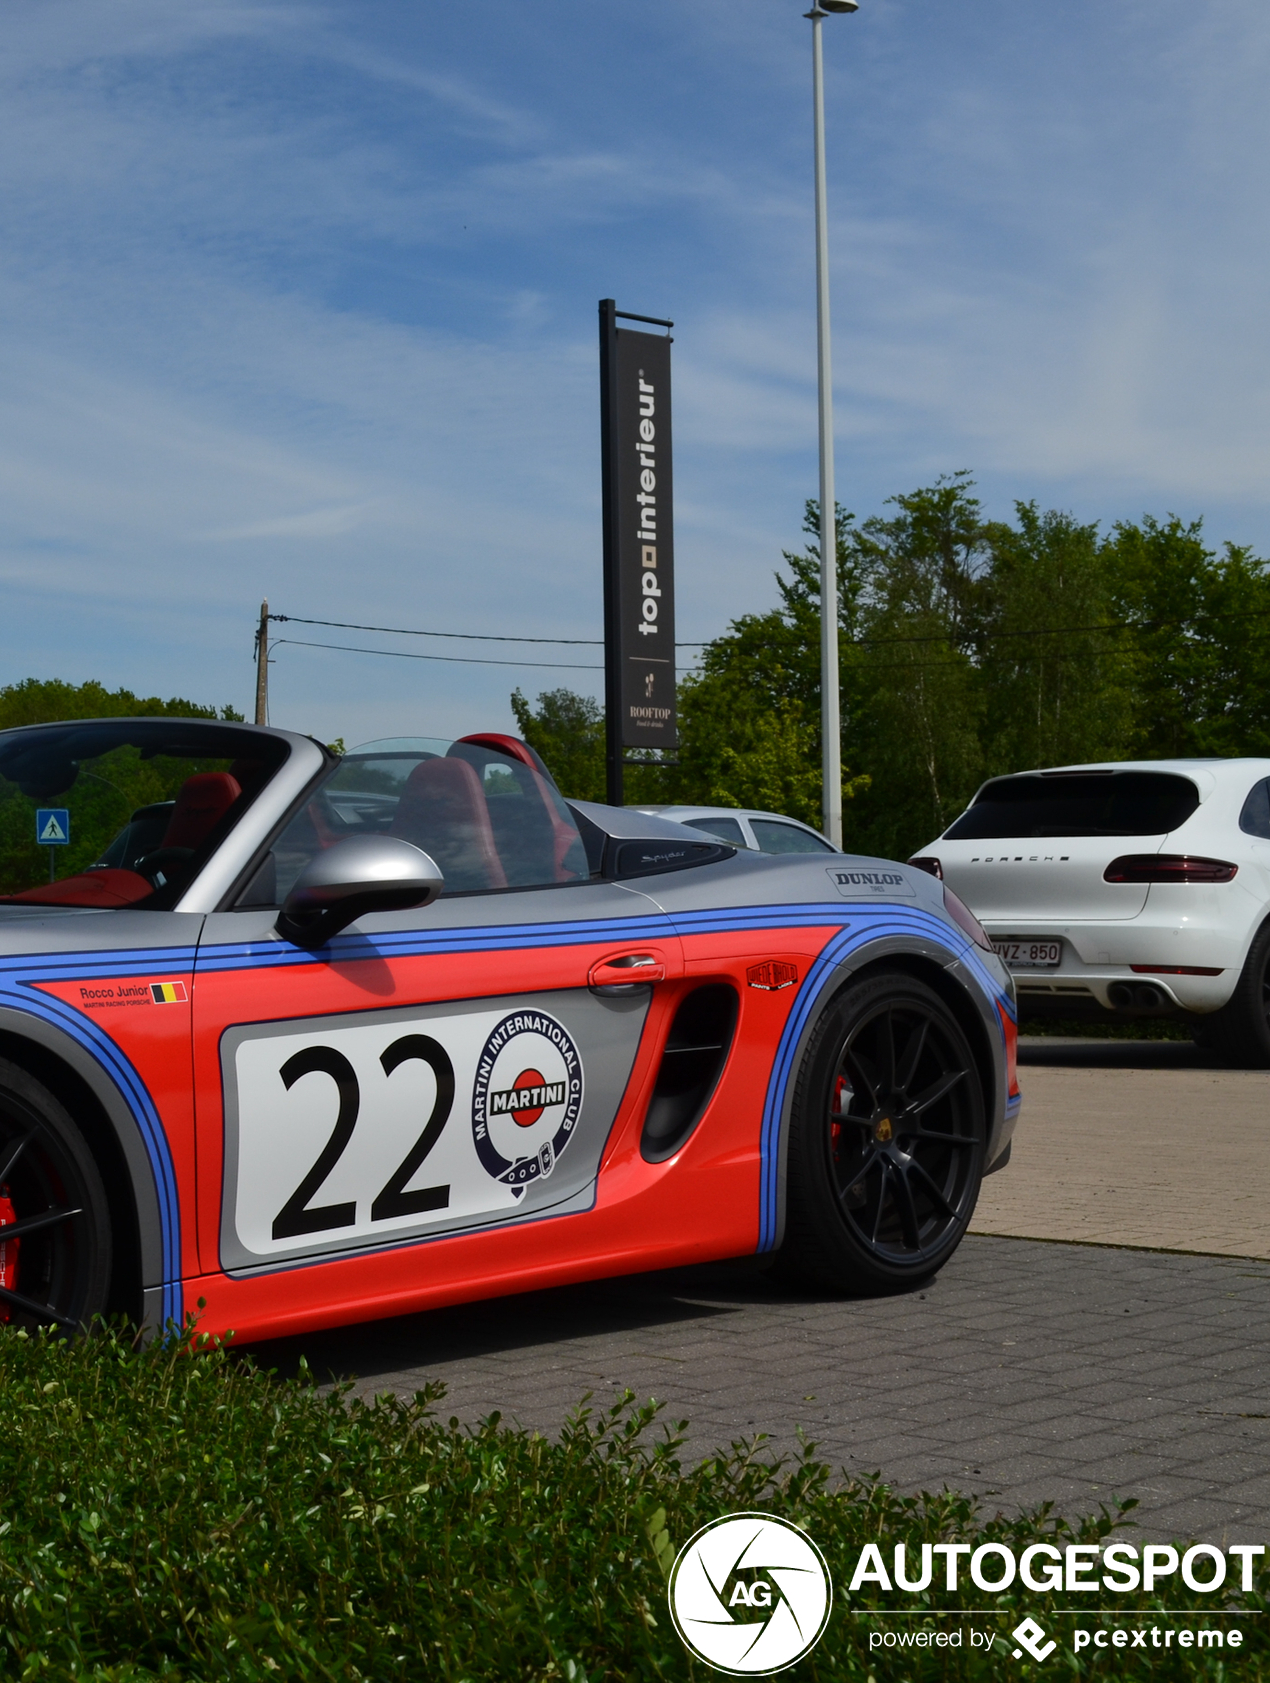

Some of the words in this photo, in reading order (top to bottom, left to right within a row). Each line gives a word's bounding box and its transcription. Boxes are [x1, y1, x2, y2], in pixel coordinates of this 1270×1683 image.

[630, 706, 671, 719] ROOFTOP
[641, 851, 685, 862] Spyder
[835, 873, 903, 885] DUNLOP
[79, 987, 114, 999] Rocco
[117, 985, 149, 997] Junior
[474, 1055, 493, 1141] MARTINI
[488, 1015, 577, 1075] INTERNATIONAL
[562, 1078, 580, 1132] CLUB
[493, 1084, 563, 1112] MARTINI
[271, 1033, 456, 1240] 22
